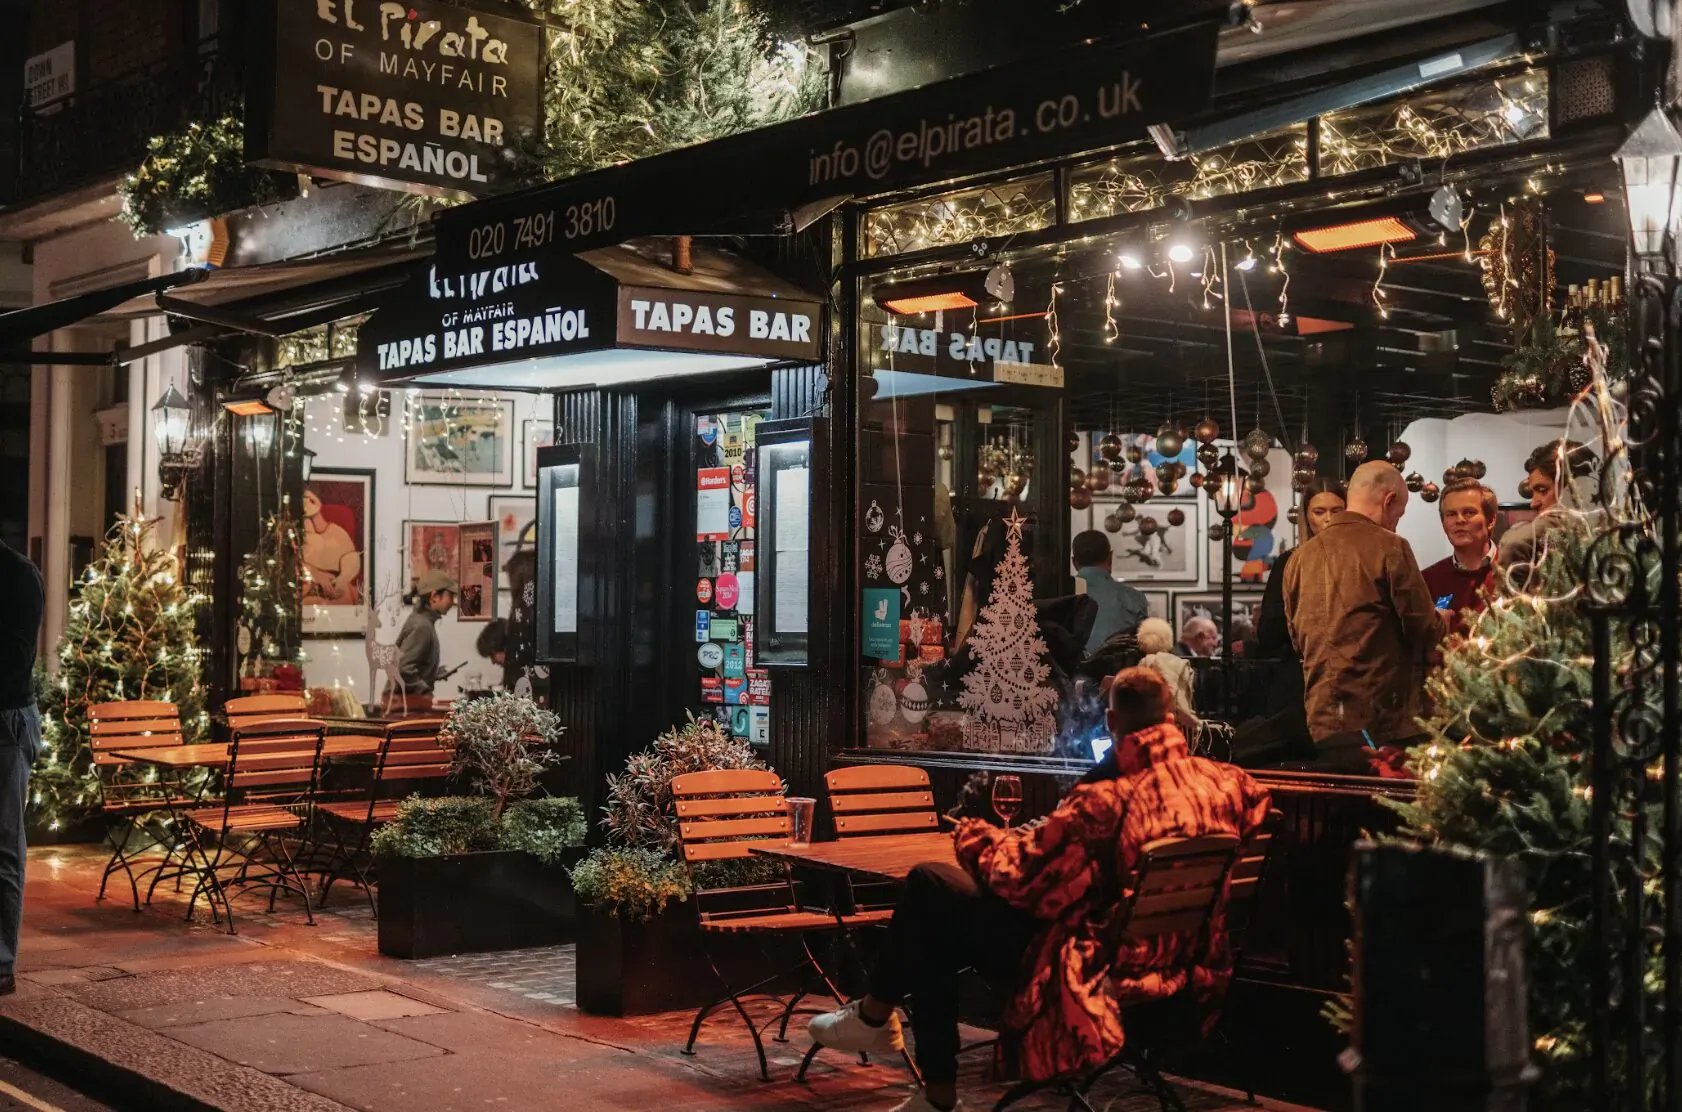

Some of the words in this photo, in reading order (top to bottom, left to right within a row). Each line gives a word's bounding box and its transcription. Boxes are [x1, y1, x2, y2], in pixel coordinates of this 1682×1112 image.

[380, 2, 508, 64] Pirata
[28, 56, 53, 84] DOWN
[315, 39, 355, 64] OF
[380, 52, 507, 97] MAYFAIR
[317, 85, 424, 131] TAPAS
[440, 108, 504, 146] BAR
[333, 129, 487, 183] ESPAÑOL
[468, 222, 505, 260] 020
[512, 211, 555, 250] 7491
[564, 196, 616, 240] 3810
[377, 333, 436, 370] TAPAS
[444, 326, 484, 359] BAR
[492, 306, 589, 351] ESPAÑOL
[442, 312, 458, 327] OF
[462, 302, 515, 324] MAYFAIR
[631, 300, 735, 337] TAPAS
[749, 310, 811, 343] BAR
[724, 447, 742, 458] 2010
[725, 660, 743, 670] 2012
